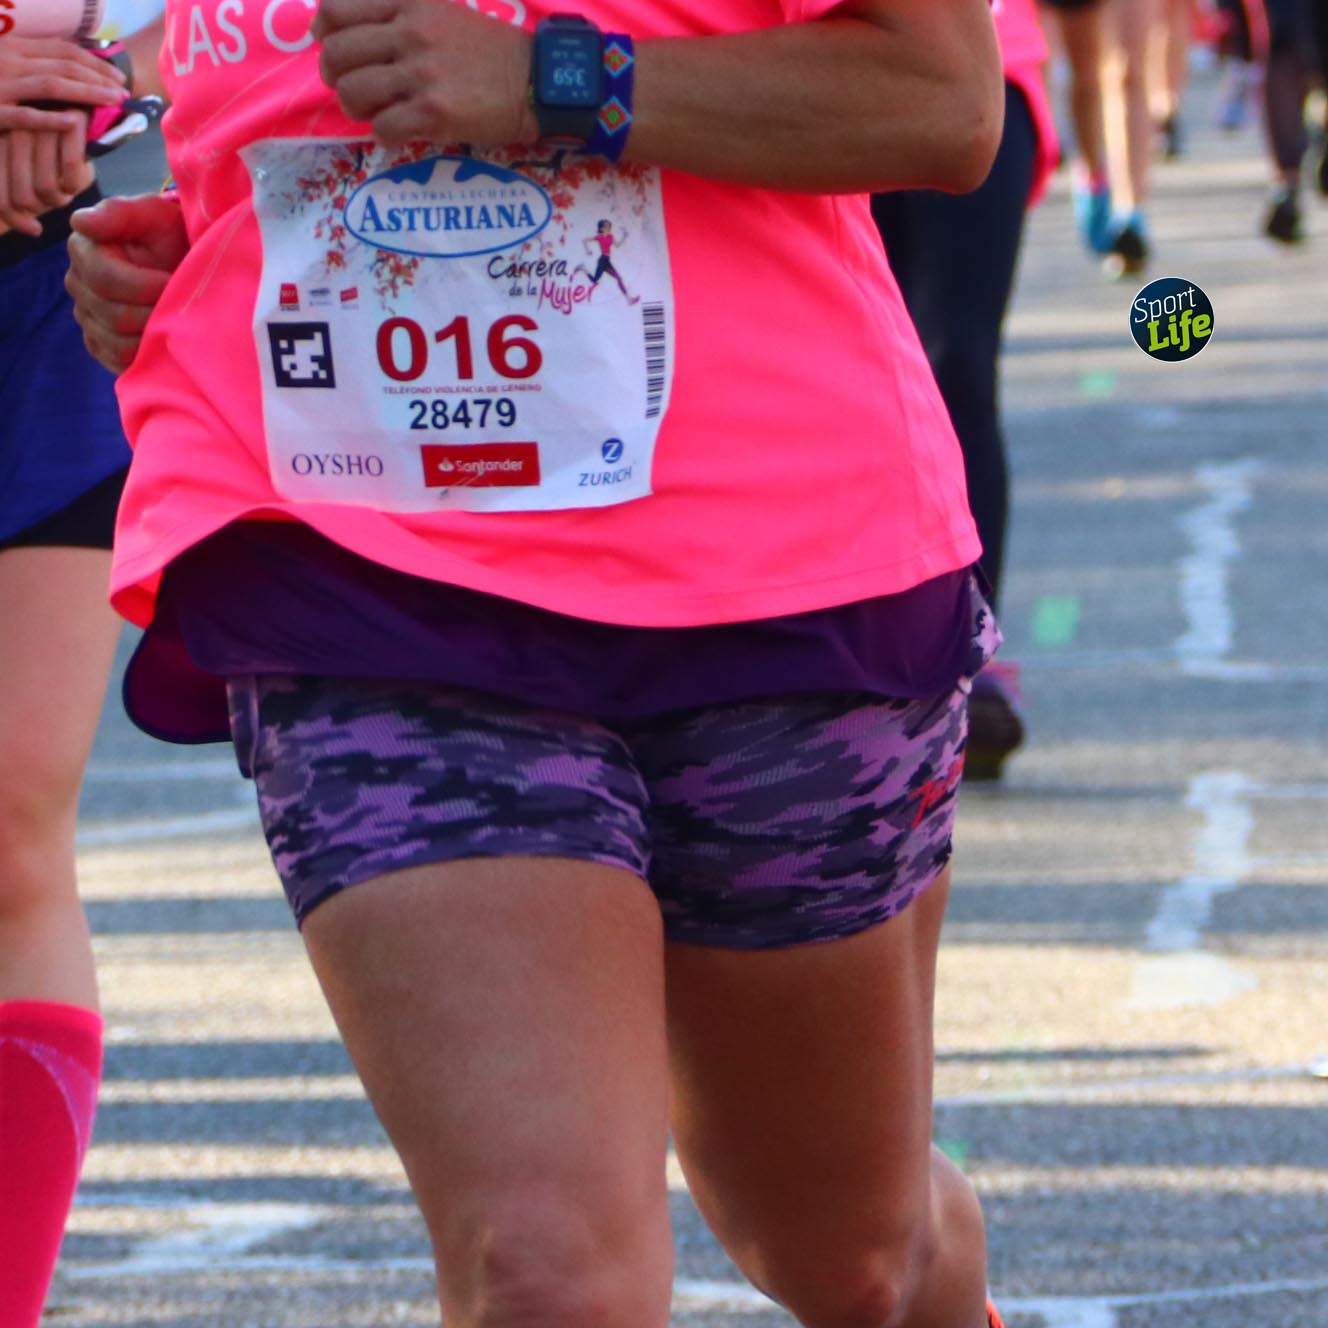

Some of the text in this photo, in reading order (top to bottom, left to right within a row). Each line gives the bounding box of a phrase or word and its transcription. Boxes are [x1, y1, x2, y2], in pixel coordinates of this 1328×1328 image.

[358, 193, 537, 233] ASTURIANA
[487, 254, 569, 280] Carrera
[537, 273, 598, 315] Mujer
[375, 314, 544, 383] 016
[408, 397, 518, 430] 28479
[291, 453, 384, 477] OYSHO
[455, 457, 524, 475] Santander
[578, 465, 633, 487] ZURICH
